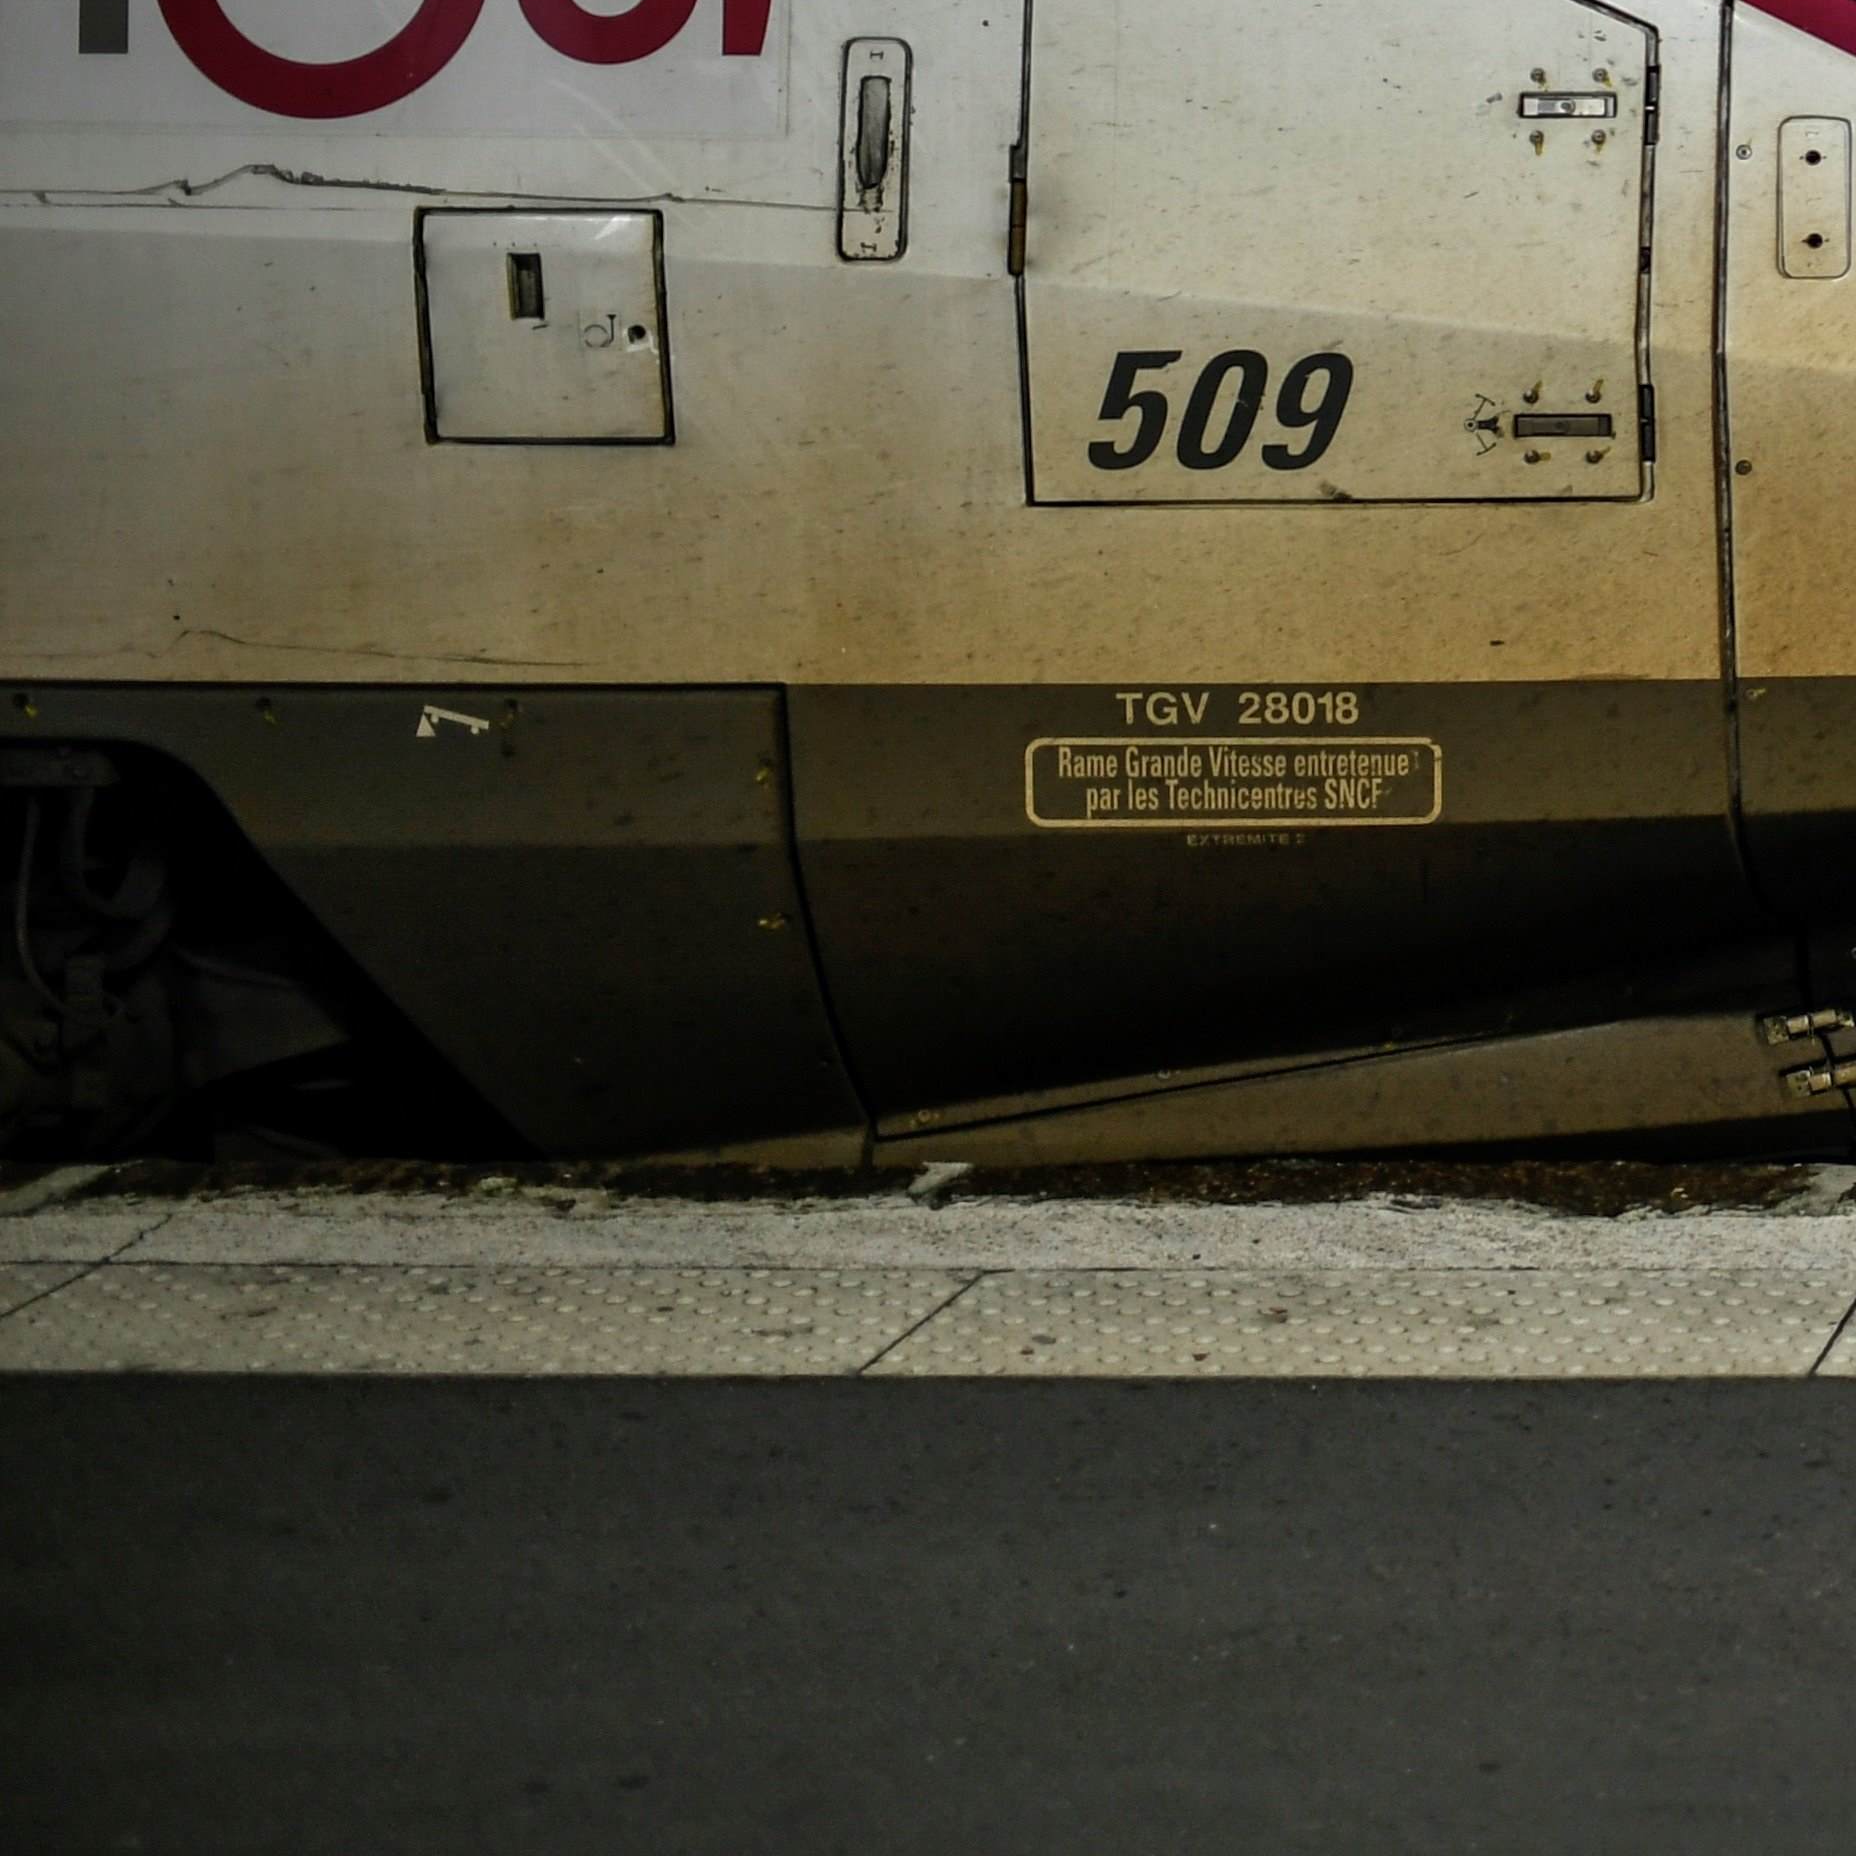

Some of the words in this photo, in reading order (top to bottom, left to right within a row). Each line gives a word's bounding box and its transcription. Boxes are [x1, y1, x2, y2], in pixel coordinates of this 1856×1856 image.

[1087, 350, 1354, 471] 509
[1115, 691, 1211, 725] TGV
[1238, 691, 1360, 725] 28018
[1058, 746, 1118, 777] Rame
[1125, 746, 1202, 777] Grande
[1208, 746, 1287, 777] Vitesse
[1293, 750, 1409, 777] entretenue
[1086, 787, 1121, 819] par
[1128, 779, 1159, 810] les
[1165, 778, 1318, 810] Technicentres
[1324, 778, 1383, 810] SNCF
